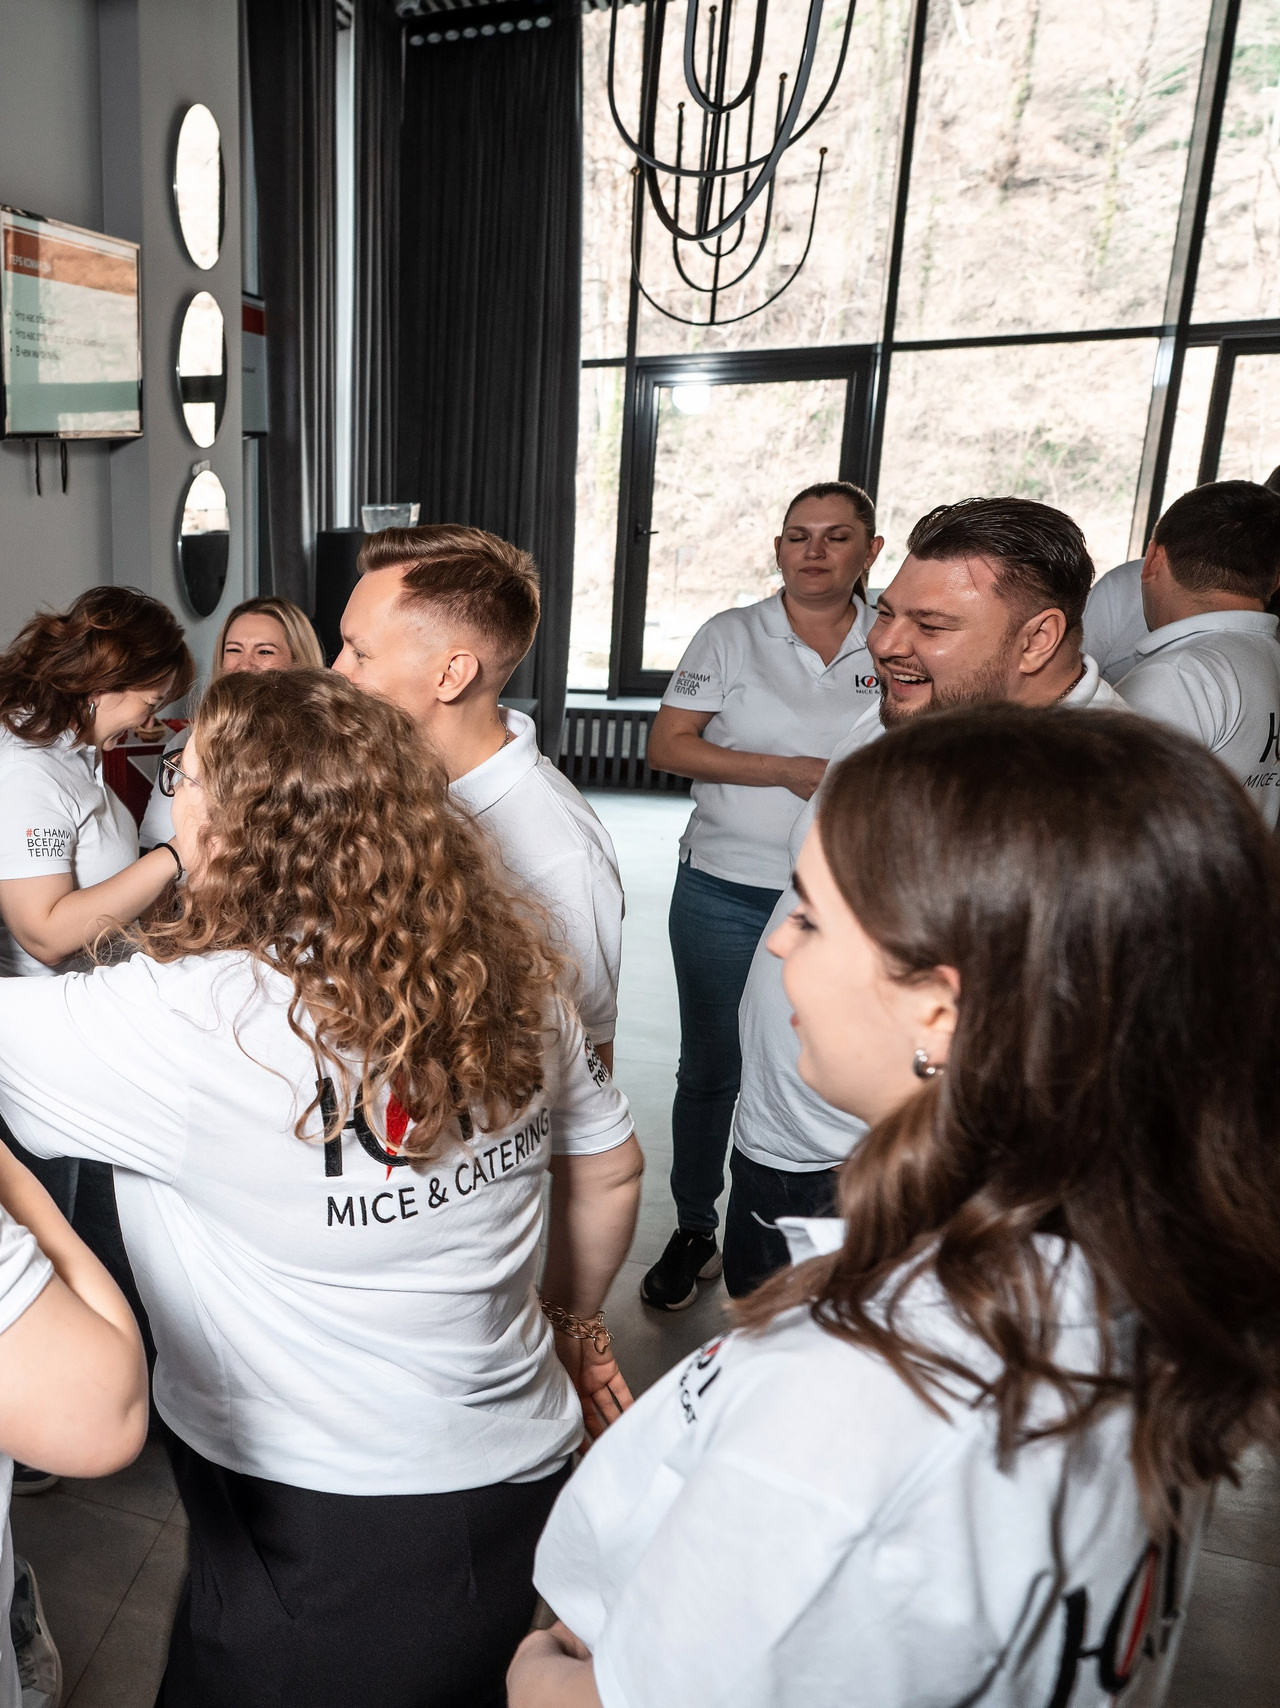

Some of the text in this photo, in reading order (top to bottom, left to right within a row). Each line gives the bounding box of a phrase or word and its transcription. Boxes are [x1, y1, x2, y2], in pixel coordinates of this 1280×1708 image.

[1243, 772, 1278, 788] MICE
[27, 838, 66, 849] ВСЕГДА
[27, 847, 64, 857] ТЕПЛО
[327, 1107, 551, 1227] MICE & CATERING
